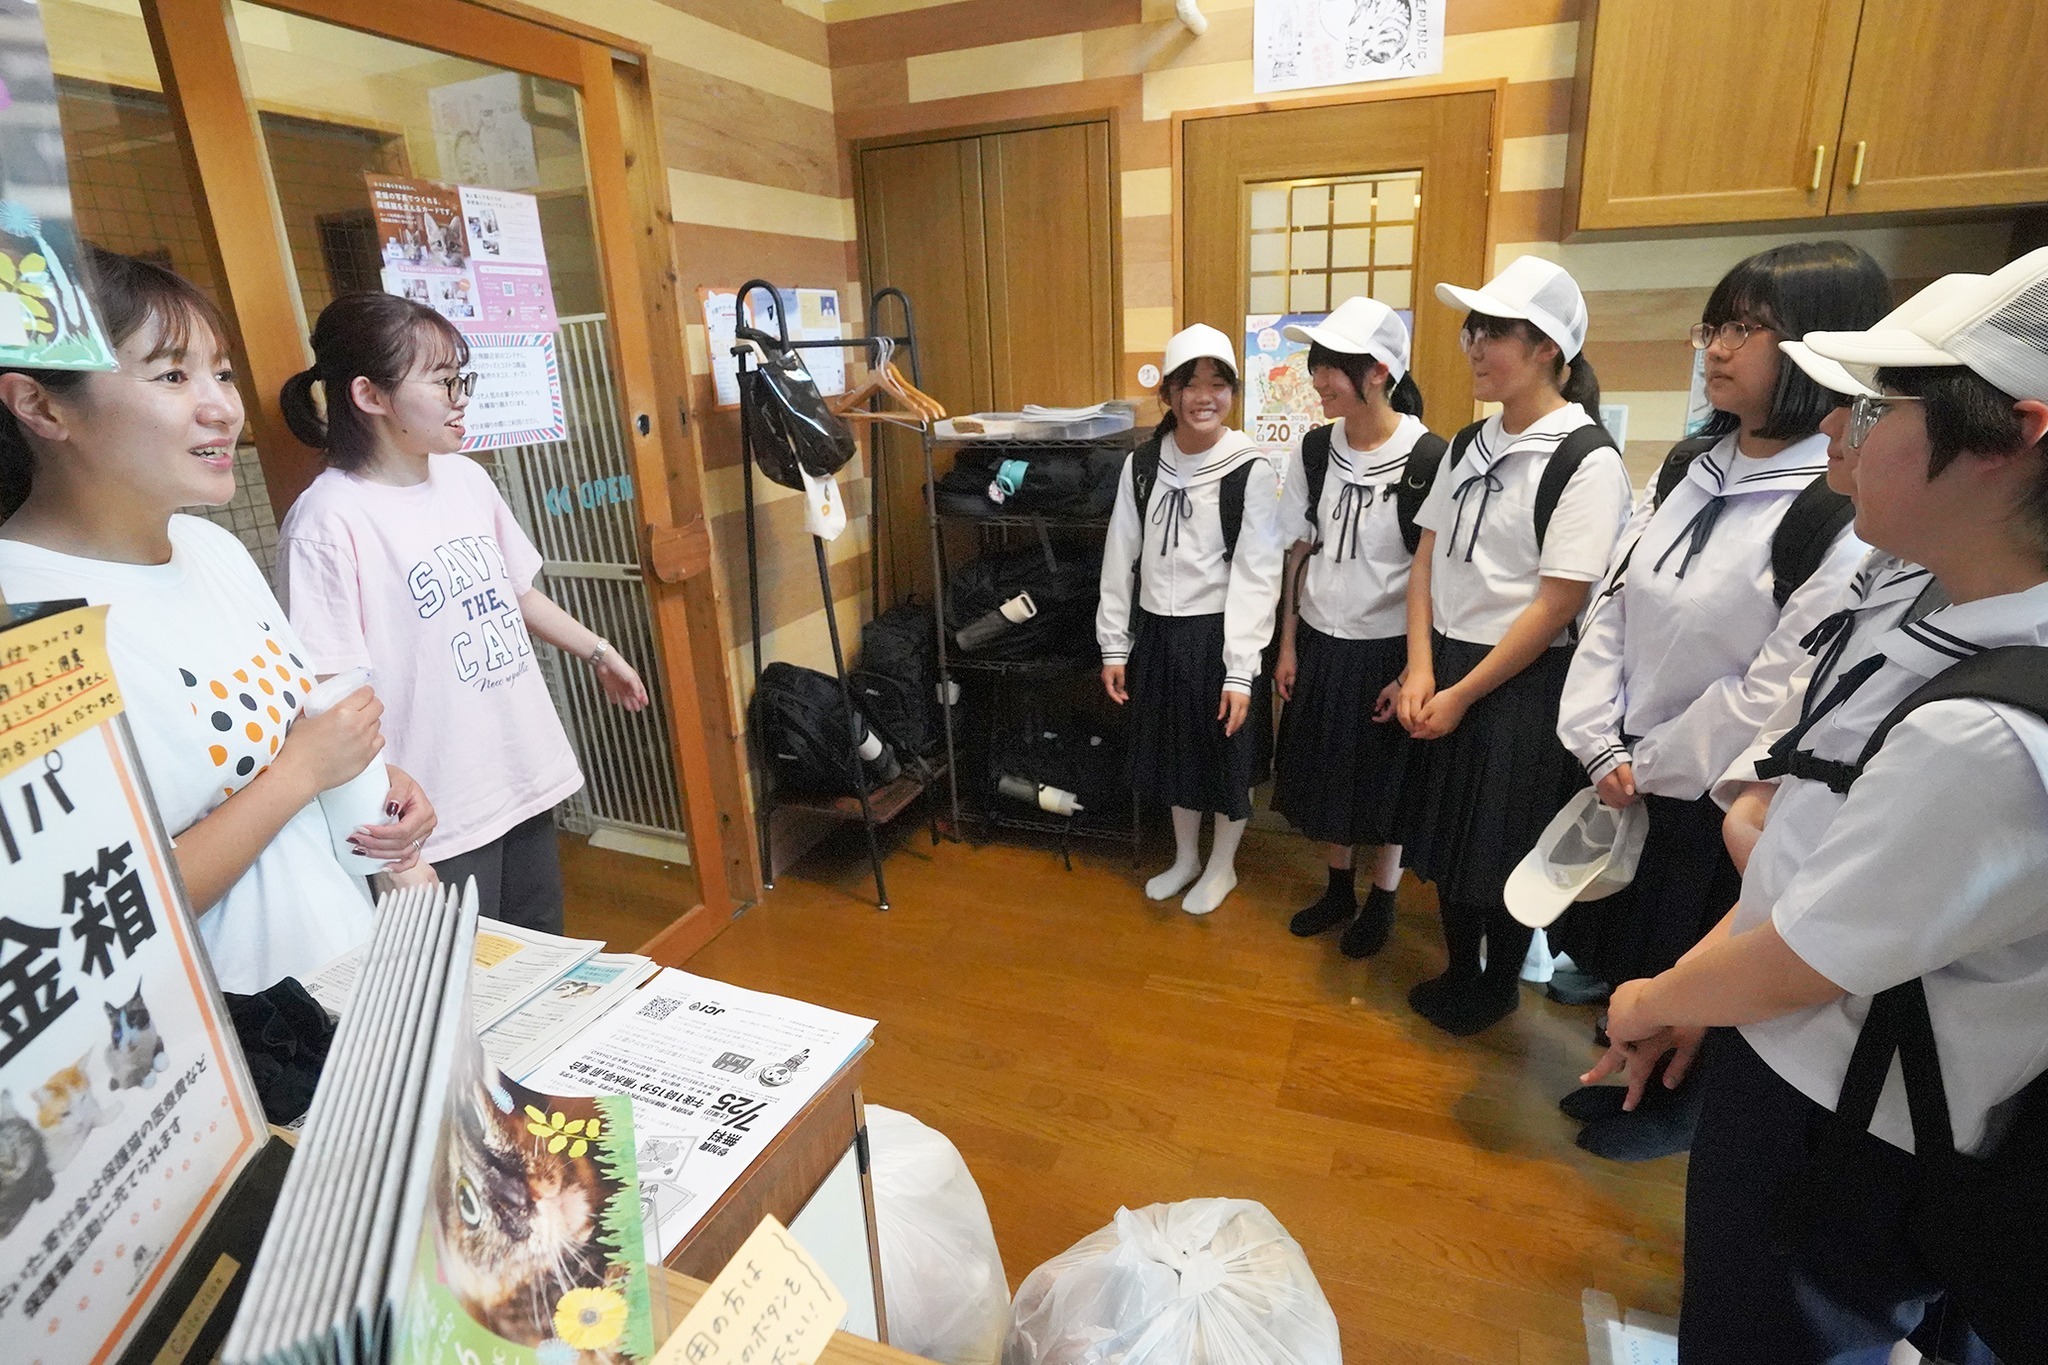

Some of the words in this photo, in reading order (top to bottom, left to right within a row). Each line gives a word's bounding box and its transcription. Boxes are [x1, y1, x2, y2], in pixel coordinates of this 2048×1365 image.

[1266, 423, 1291, 443] 20
[580, 474, 634, 510] OPEN
[462, 587, 502, 621] THE
[450, 608, 530, 683] CAT
[699, 1003, 726, 1017] JCI
[711, 1093, 768, 1133] 7/25
[698, 1141, 730, 1157] 参加費
[707, 1129, 743, 1148] 無料
